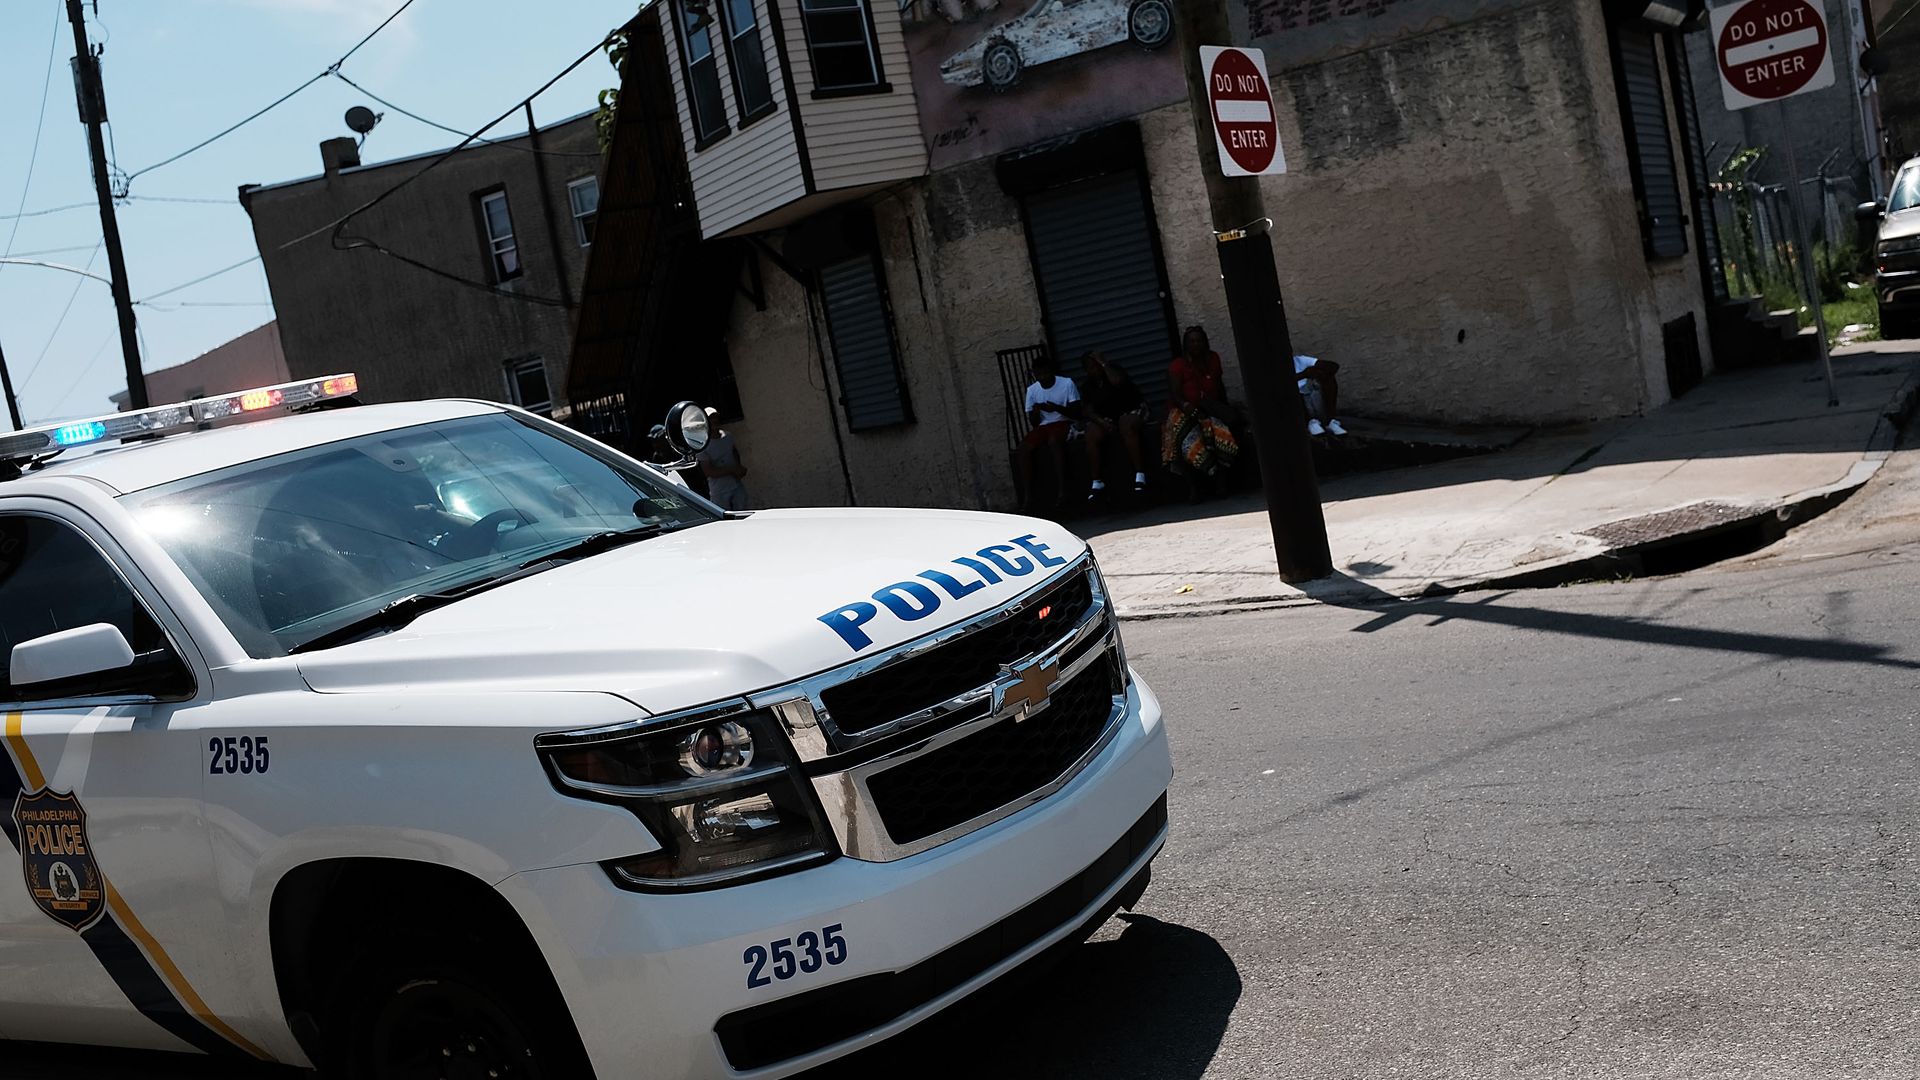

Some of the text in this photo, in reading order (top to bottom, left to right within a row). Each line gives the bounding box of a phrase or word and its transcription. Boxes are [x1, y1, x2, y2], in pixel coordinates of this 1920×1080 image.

[1730, 7, 1805, 41] DO NOT
[1215, 74, 1260, 93] DO NOT
[1745, 55, 1806, 84] ENTER
[1230, 130, 1268, 148] ENTER
[816, 533, 1067, 653] POLICE
[209, 735, 270, 774] 2535
[21, 810, 79, 821] PHILADELPHIA
[25, 824, 86, 855] POLICE
[743, 922, 848, 990] 2535
